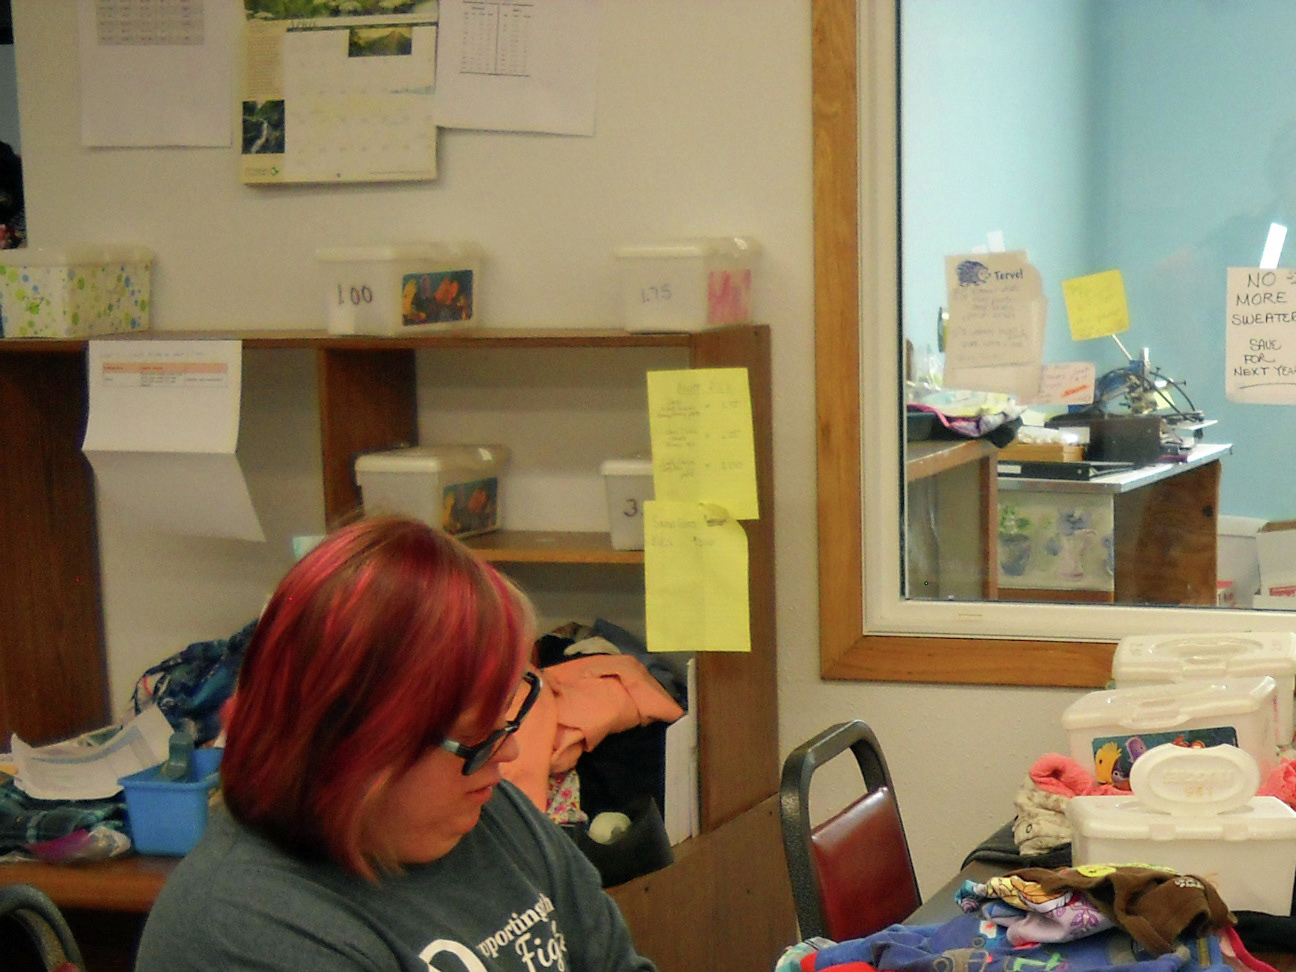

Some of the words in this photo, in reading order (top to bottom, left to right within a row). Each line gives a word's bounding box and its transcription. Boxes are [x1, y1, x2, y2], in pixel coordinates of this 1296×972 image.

[1247, 271, 1276, 288] NO
[1236, 291, 1288, 306] MORE
[1249, 338, 1281, 351] SAVE
[1244, 353, 1276, 364] FOR
[1233, 366, 1270, 376] NEXT
